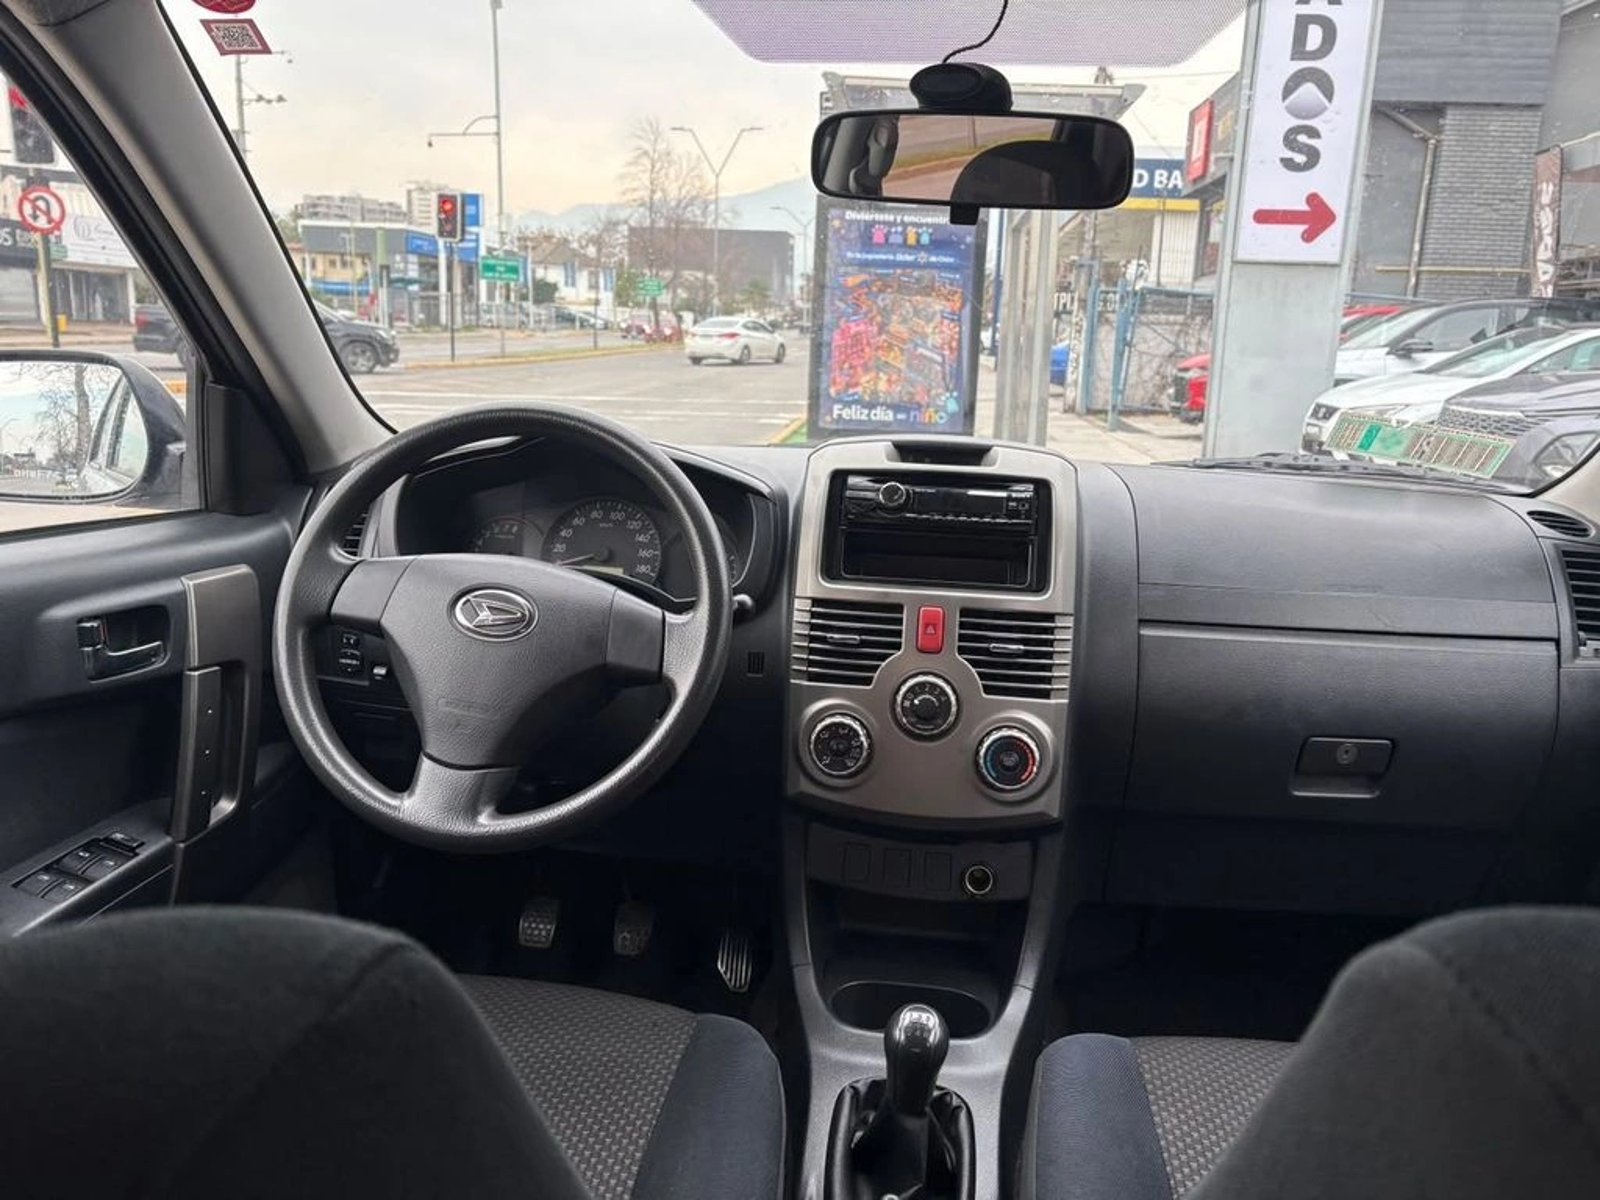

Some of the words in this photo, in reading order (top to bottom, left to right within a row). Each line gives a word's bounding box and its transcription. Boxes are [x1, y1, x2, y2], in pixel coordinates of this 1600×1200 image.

[1279, 0, 1342, 173] DOS
[903, 214, 950, 225] encuentr
[832, 404, 869, 420] Feliz
[870, 406, 894, 421] día
[609, 511, 626, 521] 100
[560, 527, 573, 538] 40
